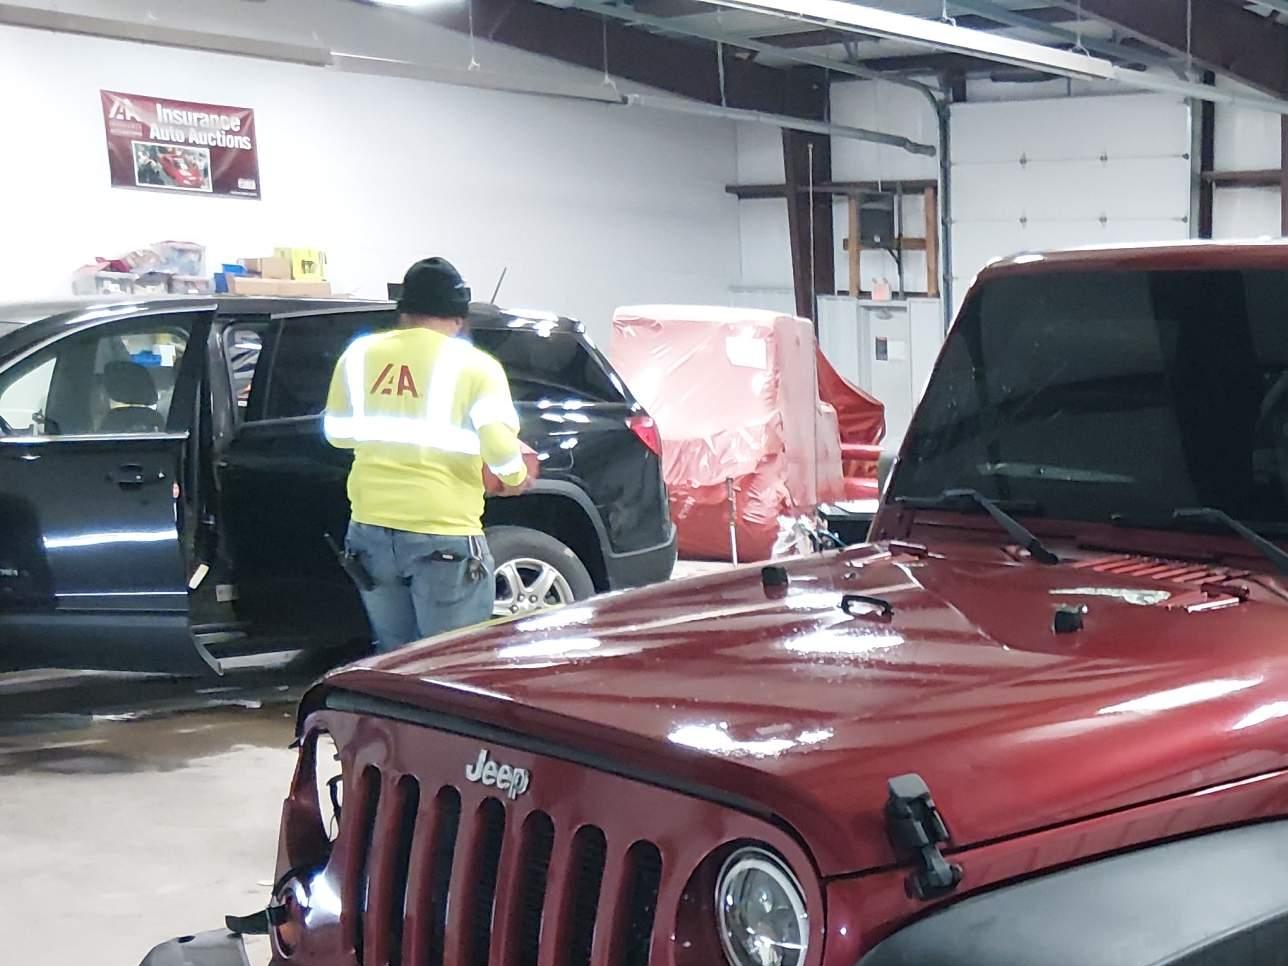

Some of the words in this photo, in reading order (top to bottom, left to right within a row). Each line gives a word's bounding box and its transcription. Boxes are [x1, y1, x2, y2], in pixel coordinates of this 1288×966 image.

[155, 103, 241, 132] Insurance
[149, 123, 186, 144] Auto
[188, 129, 252, 151] Auctions
[465, 749, 529, 801] Jeep
